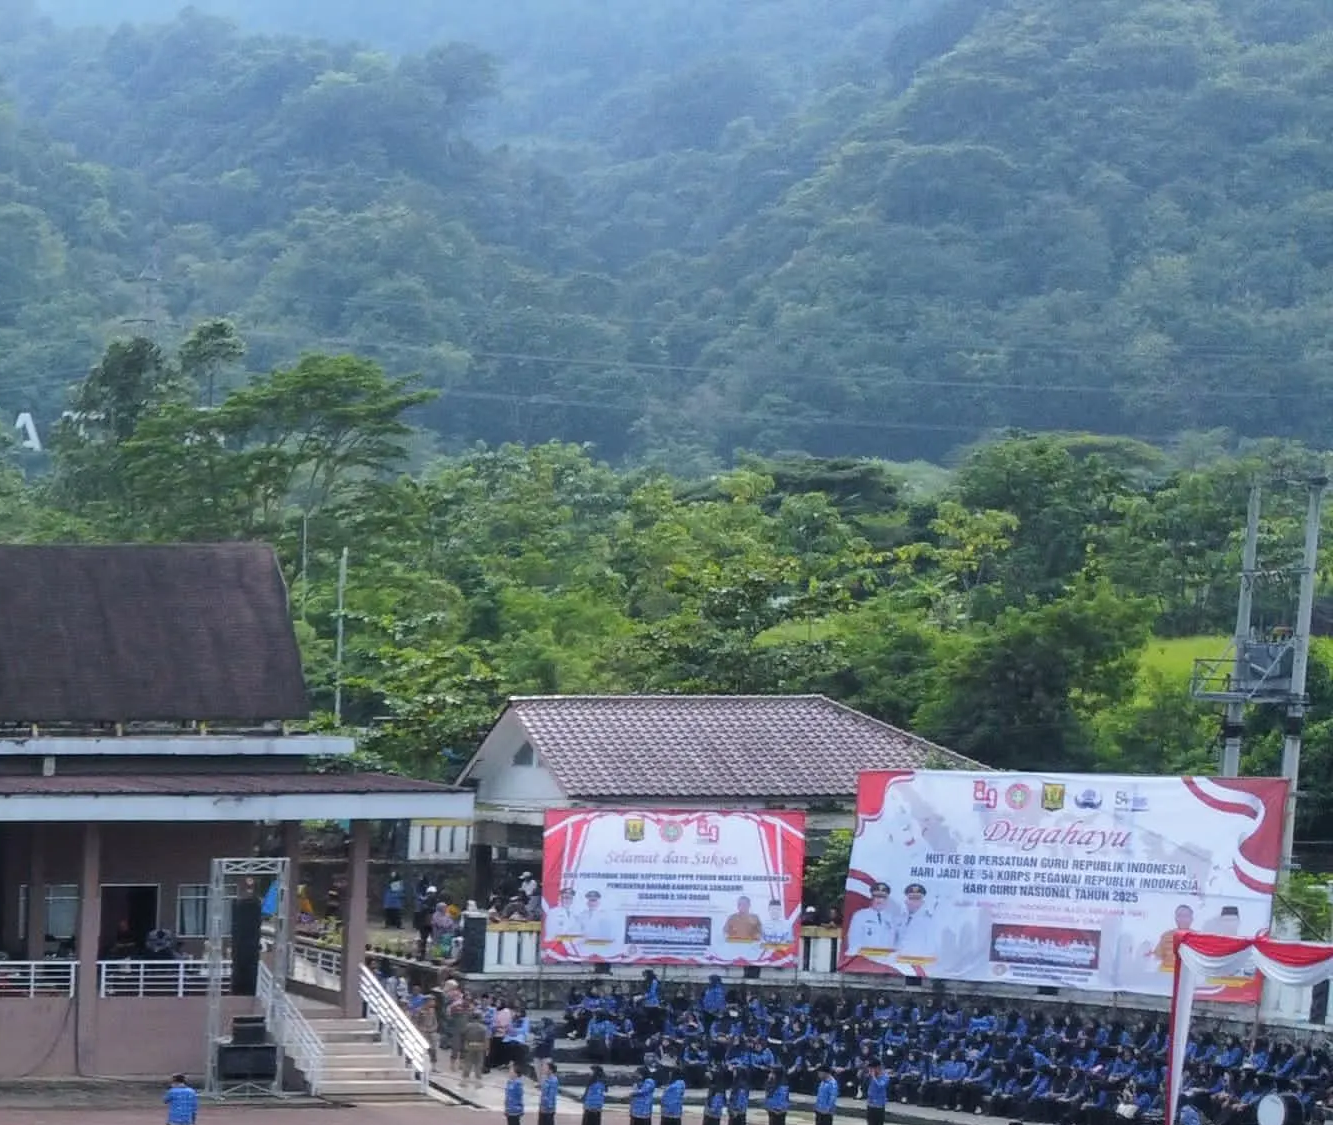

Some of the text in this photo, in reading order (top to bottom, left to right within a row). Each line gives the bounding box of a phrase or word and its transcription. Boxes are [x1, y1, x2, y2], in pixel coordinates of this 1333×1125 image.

[983, 819, 1133, 854] Dirgahayu
[604, 849, 739, 868] Selamat dan Sukses
[925, 852, 1188, 876] HUT KE 80 PERSATUAN GURU REPUBLIK INDONESIA
[909, 866, 934, 878] HARI
[936, 867, 961, 879] JADI
[996, 870, 1031, 882] KORPS
[1033, 872, 1082, 884] PEGAWAI
[1084, 875, 1136, 888] REPUBLIK
[1139, 877, 1199, 891] INDONESIA
[963, 883, 1140, 903] HARI GURU NASIONAL TAHUN 2025
